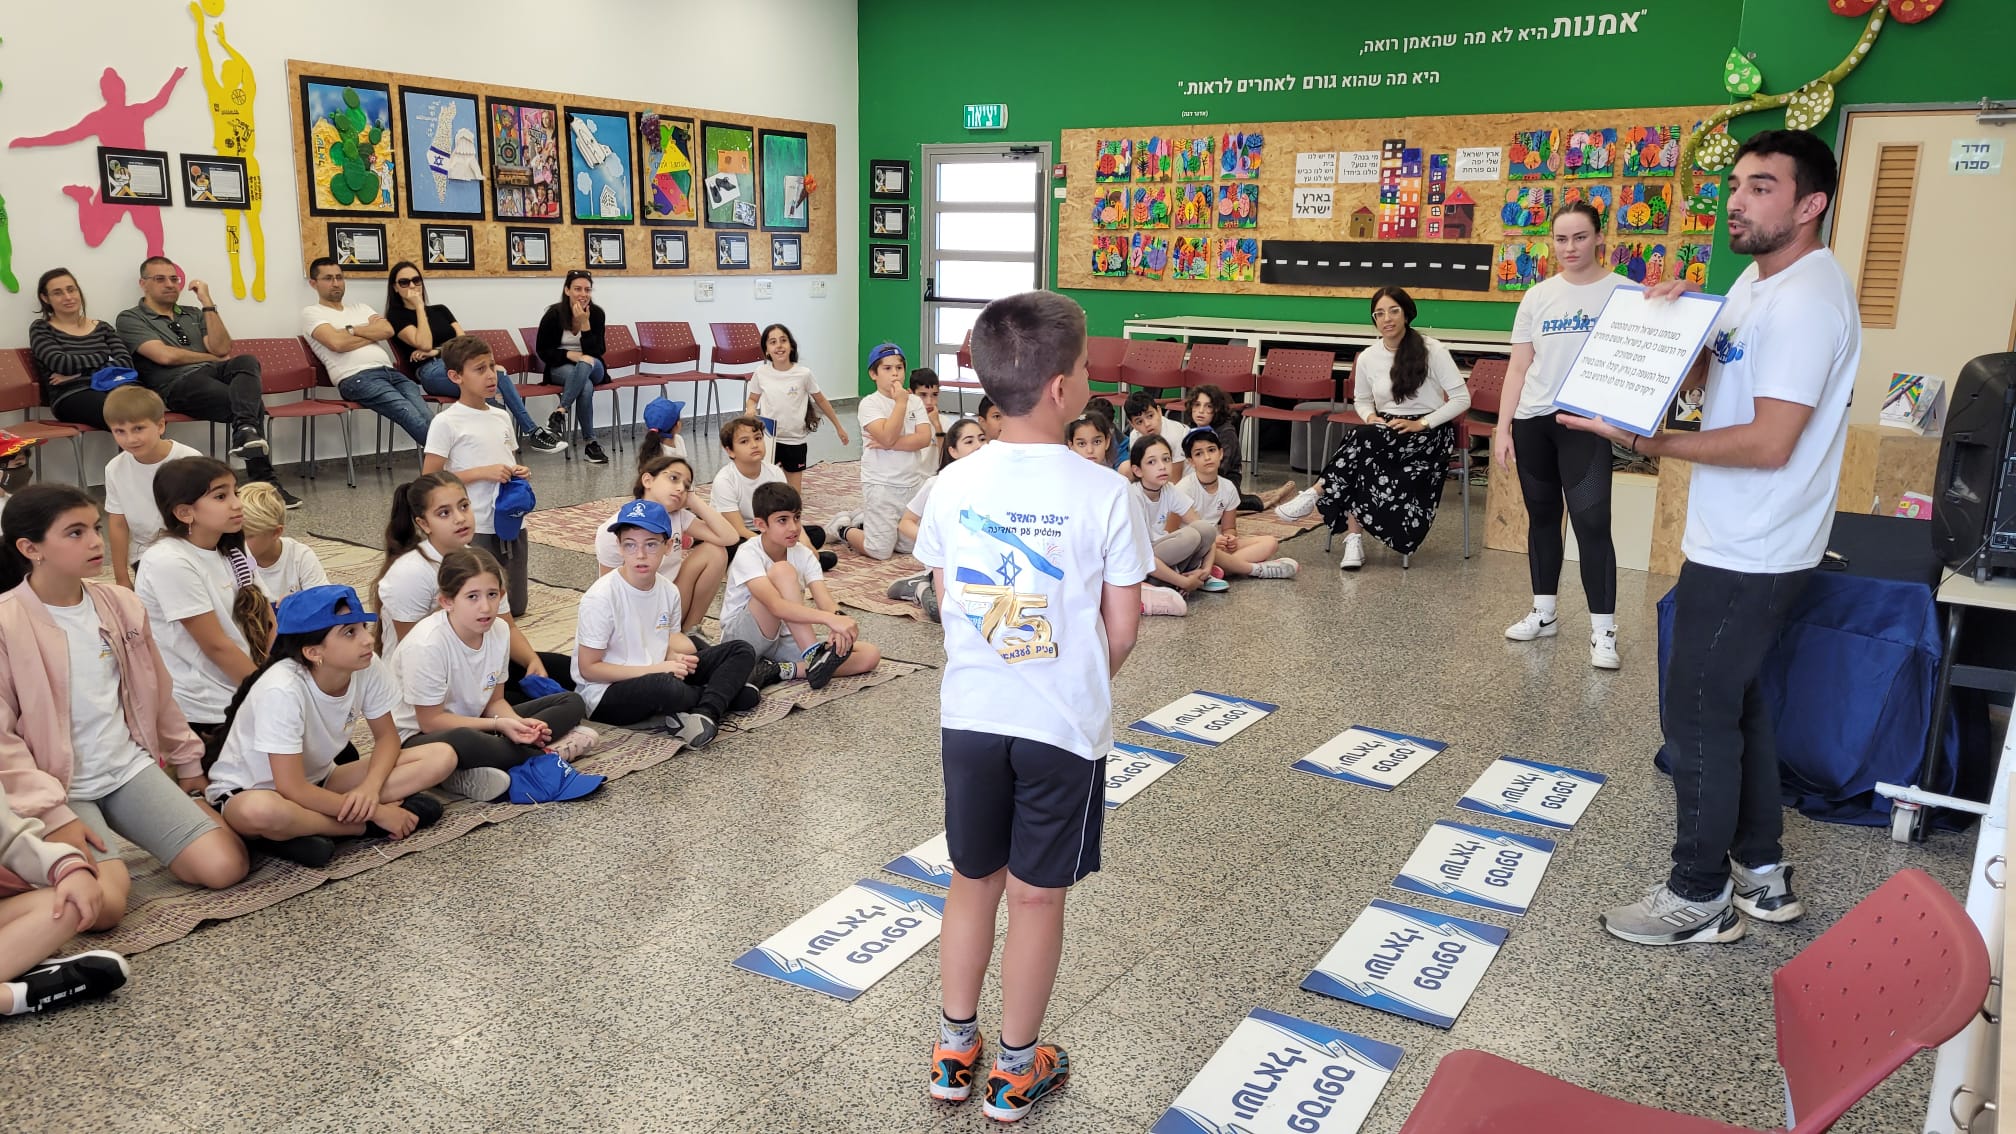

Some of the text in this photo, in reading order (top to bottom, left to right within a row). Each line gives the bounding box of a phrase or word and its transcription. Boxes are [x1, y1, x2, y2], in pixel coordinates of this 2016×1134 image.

[1359, 9, 1648, 56] "אמנות היא לא מה שהאמן רואה,
[1237, 74, 1296, 93] לאחרים
[1302, 74, 1338, 91] גורם
[1341, 71, 1382, 88] שהוא
[1386, 72, 1407, 86] מה
[1412, 70, 1440, 85] היא
[967, 106, 997, 127] יציאה
[1961, 144, 1990, 153] חדר
[1955, 160, 1990, 171] ספרון
[1296, 203, 1330, 214] ישראל
[1302, 193, 1331, 204] בארץ
[1542, 314, 1599, 332] ראליאדה
[1020, 527, 1032, 536] עם
[961, 583, 1053, 647] 75
[1001, 644, 1031, 660] לעצמא
[1175, 703, 1222, 726] ישראלי
[1204, 709, 1248, 731] פסיפס
[1338, 740, 1386, 767] ישראלי
[1372, 747, 1417, 773] פסיפס
[1502, 772, 1542, 804] ישראלי
[1540, 780, 1578, 810] פסיפס
[1440, 839, 1486, 881] ישראלי
[1484, 849, 1524, 888] פסיפס
[806, 904, 887, 956] ישראלי
[846, 916, 922, 965] פסיפס
[1364, 927, 1424, 980] ישראלי
[1414, 940, 1467, 991] פסיפס
[1231, 1046, 1308, 1121] ישראלי
[1286, 1064, 1356, 1134] פסיפס
